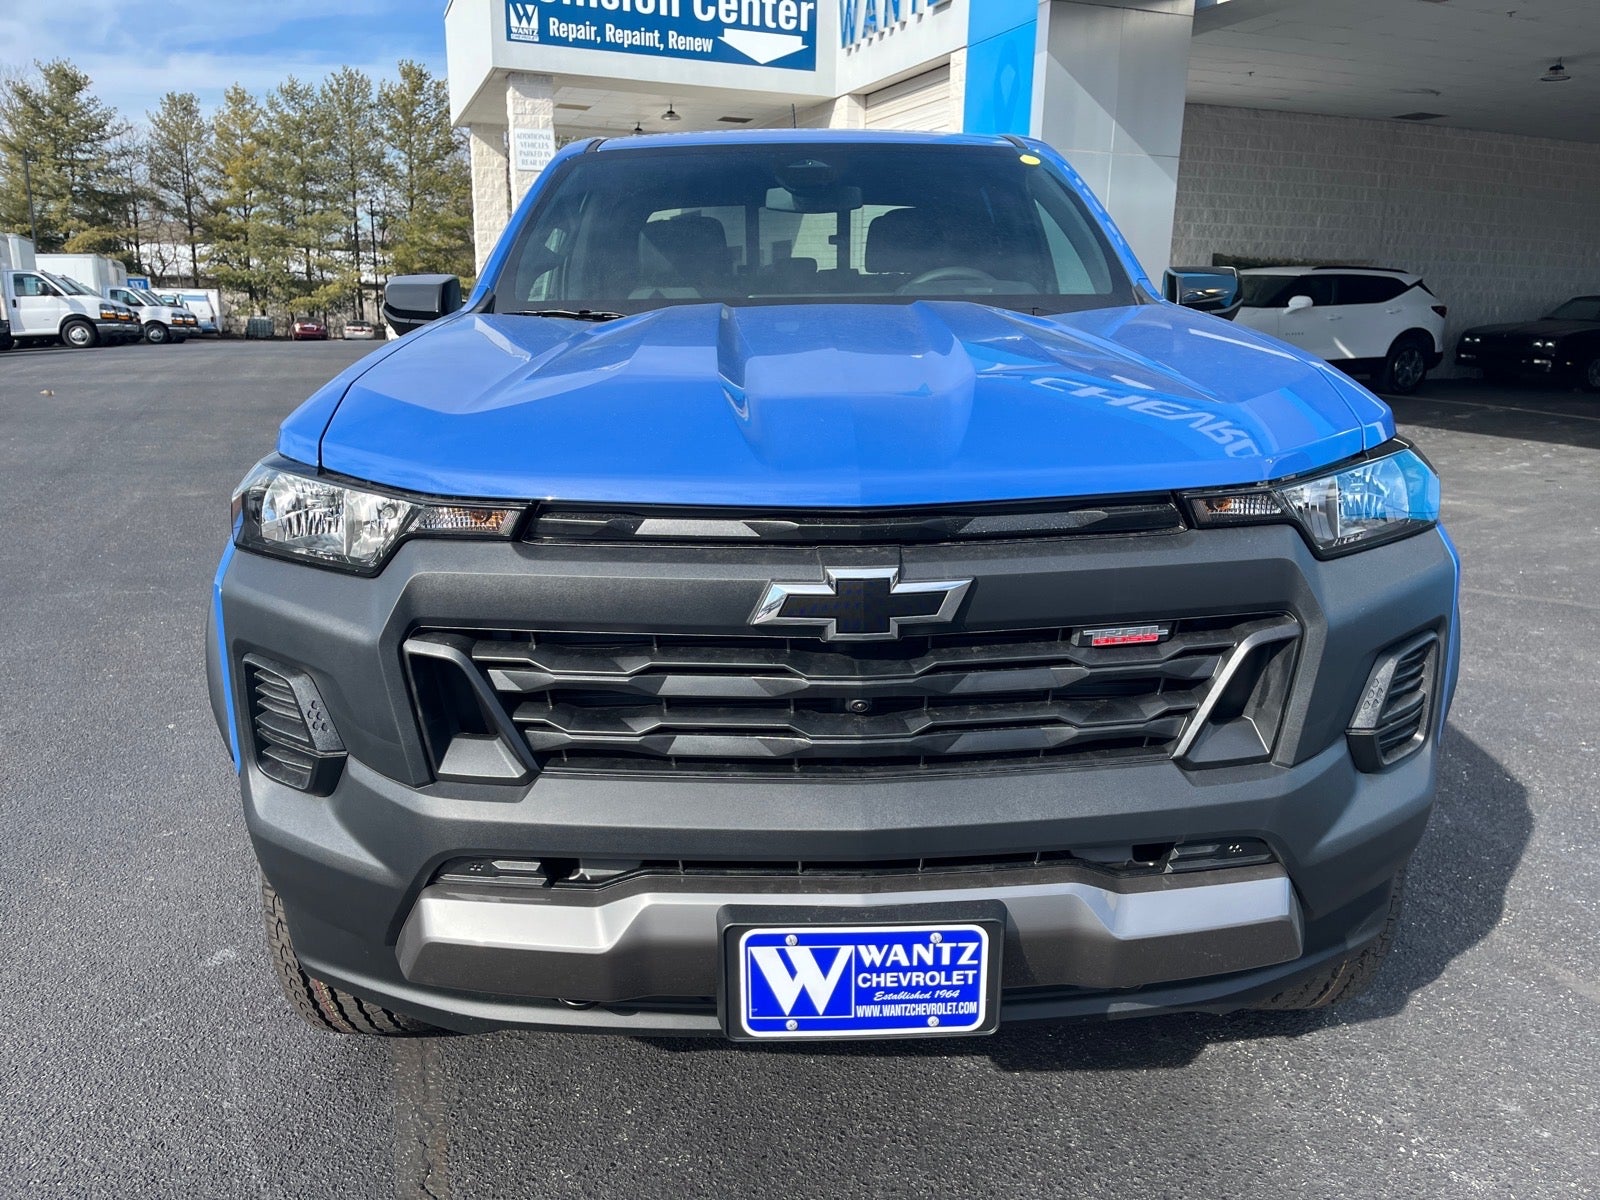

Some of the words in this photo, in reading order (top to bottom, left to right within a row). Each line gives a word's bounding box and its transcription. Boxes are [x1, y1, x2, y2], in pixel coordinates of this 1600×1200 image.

[511, 27, 538, 35] WANTZ
[549, 17, 601, 44] Repair,
[605, 23, 664, 51] Repaint,
[668, 30, 714, 53] Renew
[520, 141, 549, 149] VEHICLES
[857, 942, 979, 968] WANTZ
[857, 970, 977, 988] CHEVROLET
[873, 990, 931, 1002] Established
[934, 989, 960, 1000] 1964
[856, 1001, 978, 1018] WWW.WANTZCHEVROLET.COM
